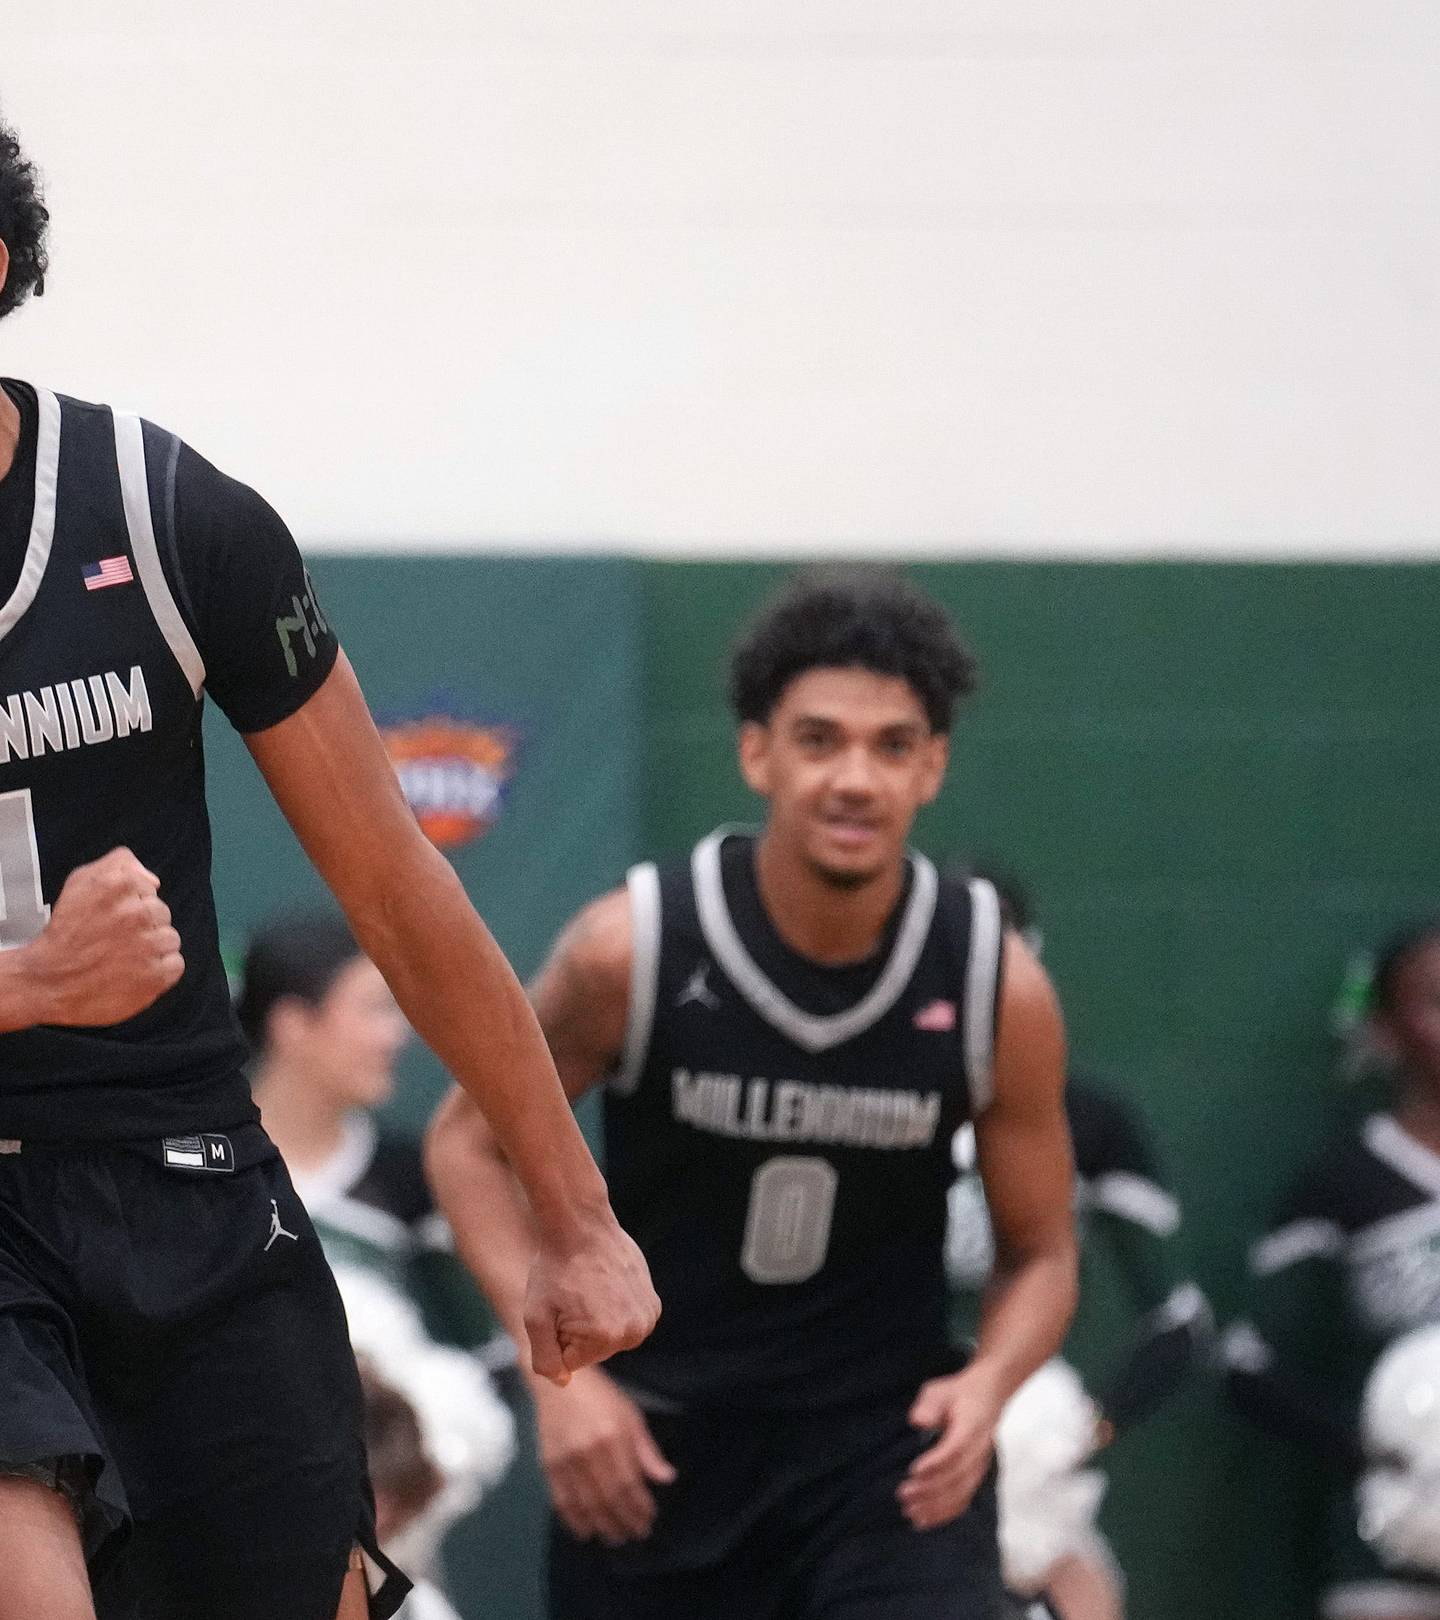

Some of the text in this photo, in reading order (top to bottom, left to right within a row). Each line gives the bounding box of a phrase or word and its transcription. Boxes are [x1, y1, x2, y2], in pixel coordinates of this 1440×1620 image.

[671, 1067, 942, 1149] MILLENNIUM
[211, 1143, 226, 1160] M
[740, 1156, 838, 1284] 0
